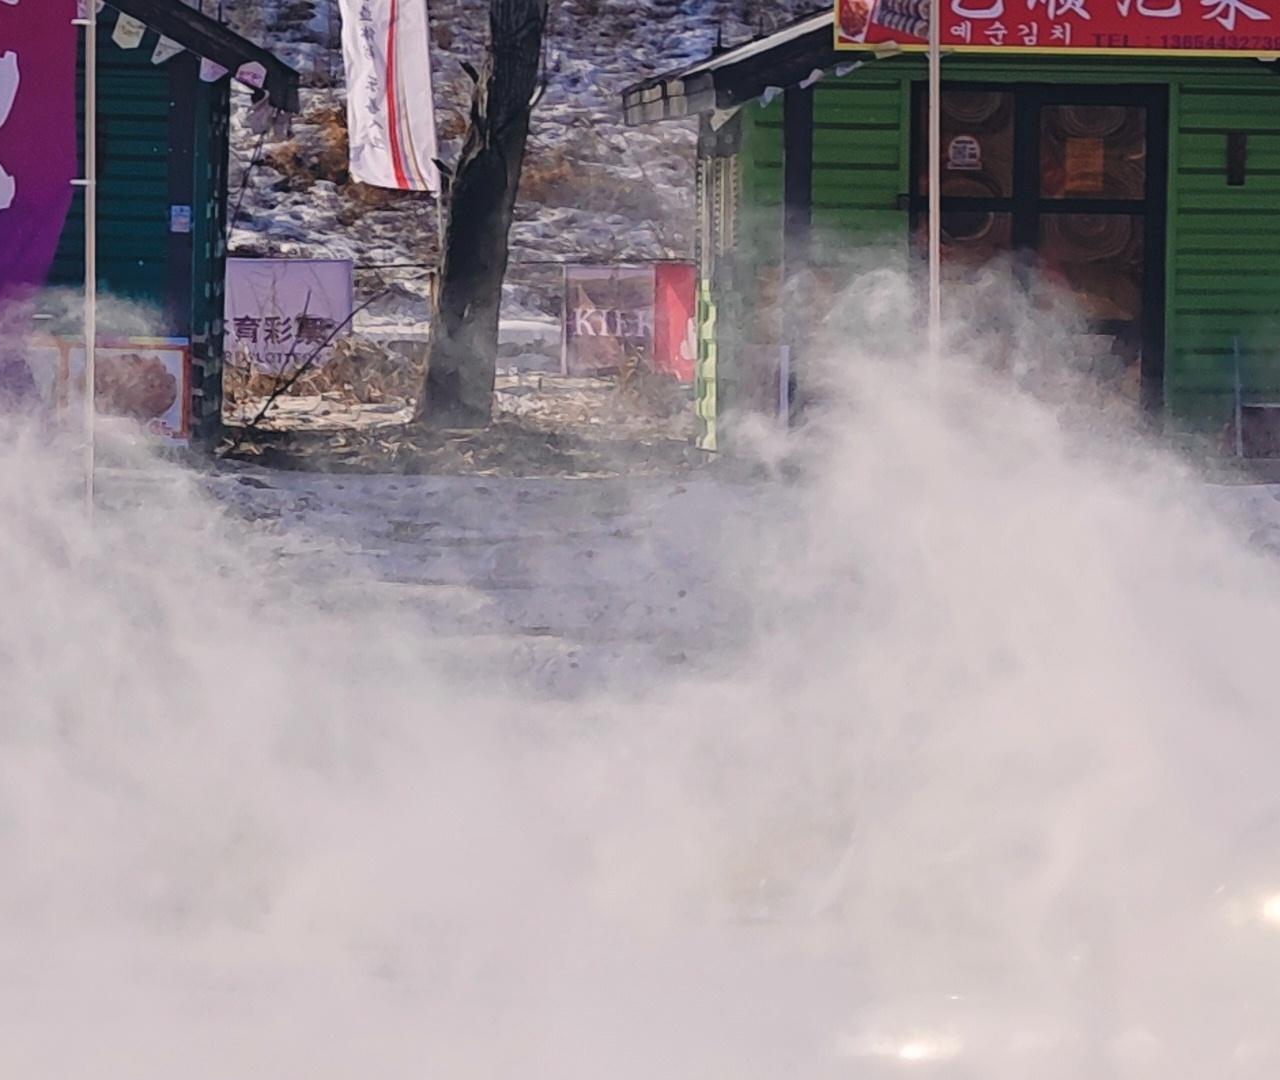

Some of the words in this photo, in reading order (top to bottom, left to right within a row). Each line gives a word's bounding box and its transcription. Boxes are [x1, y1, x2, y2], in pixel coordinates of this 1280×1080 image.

[949, 20, 1072, 46] 예순김치
[223, 315, 333, 344] 育彩票
